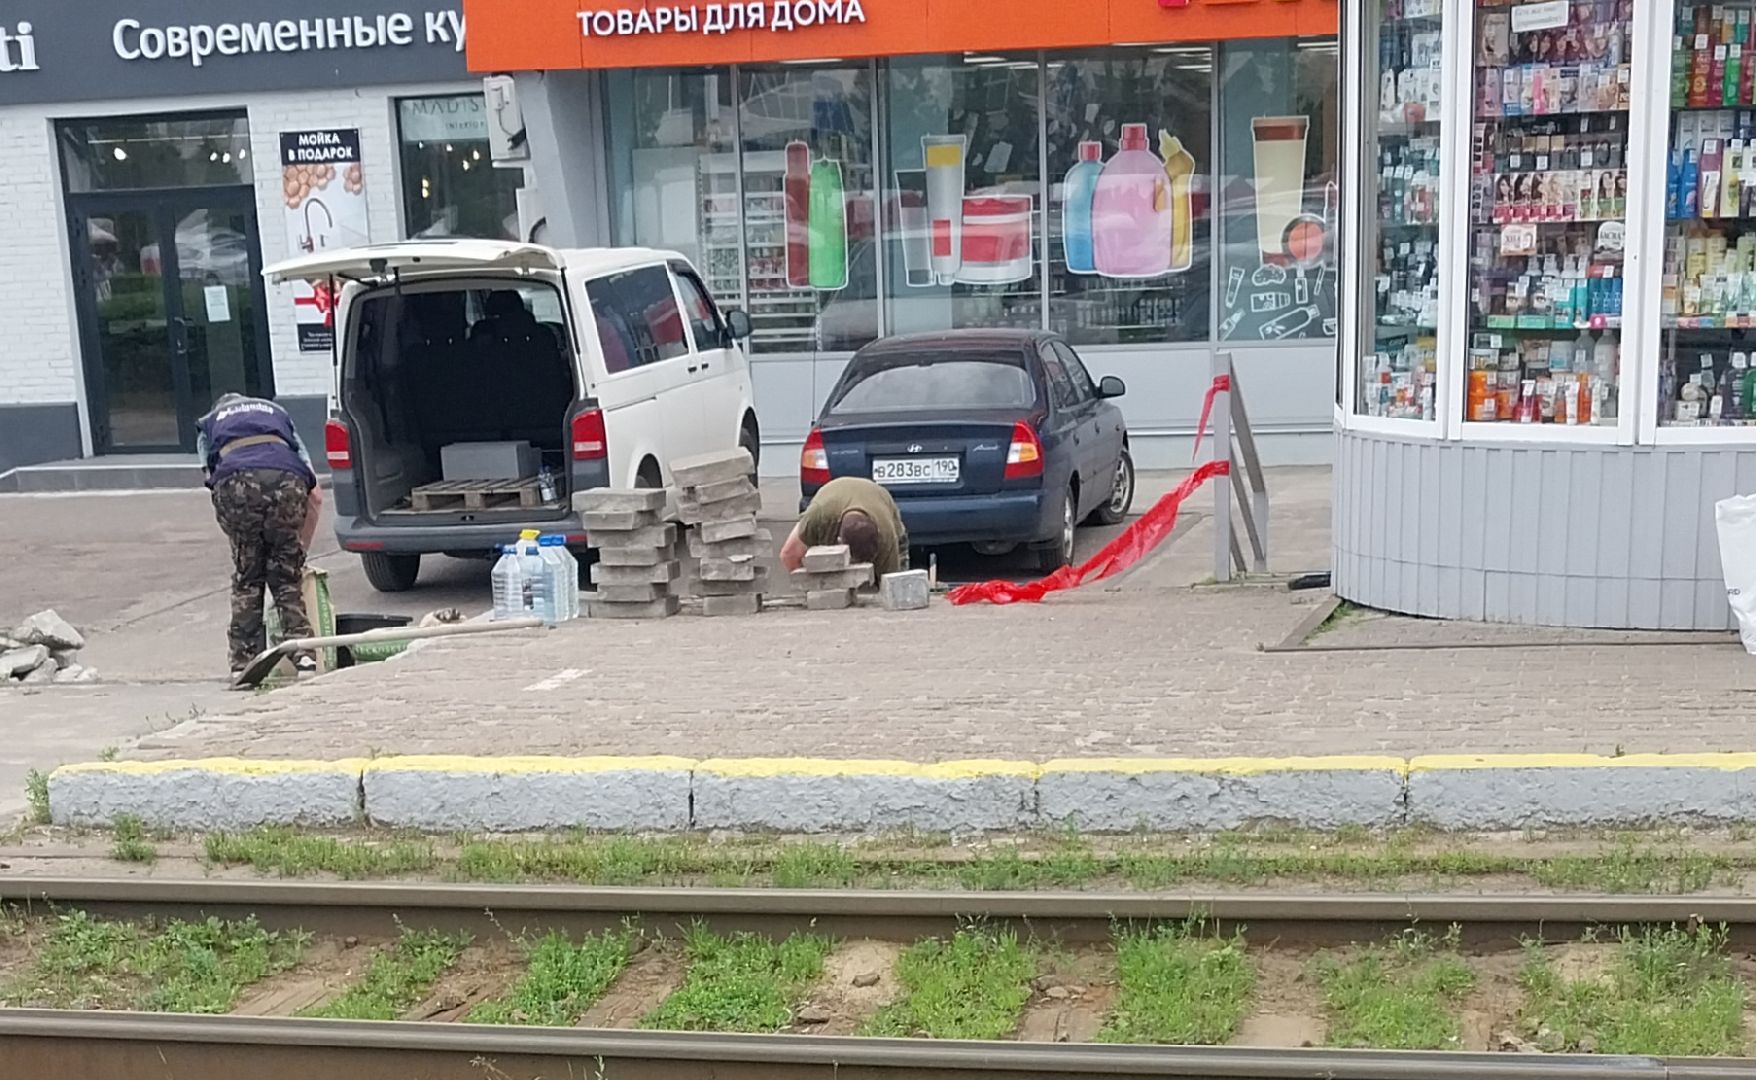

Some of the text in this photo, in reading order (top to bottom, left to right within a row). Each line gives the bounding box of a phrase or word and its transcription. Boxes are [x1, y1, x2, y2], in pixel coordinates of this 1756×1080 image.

[576, 0, 866, 37] ТОВАРЫ ДЛЯ ДОМА
[112, 13, 414, 67] Современные
[298, 131, 341, 146] МОЙКА
[287, 145, 353, 161] В ПОДАРОК
